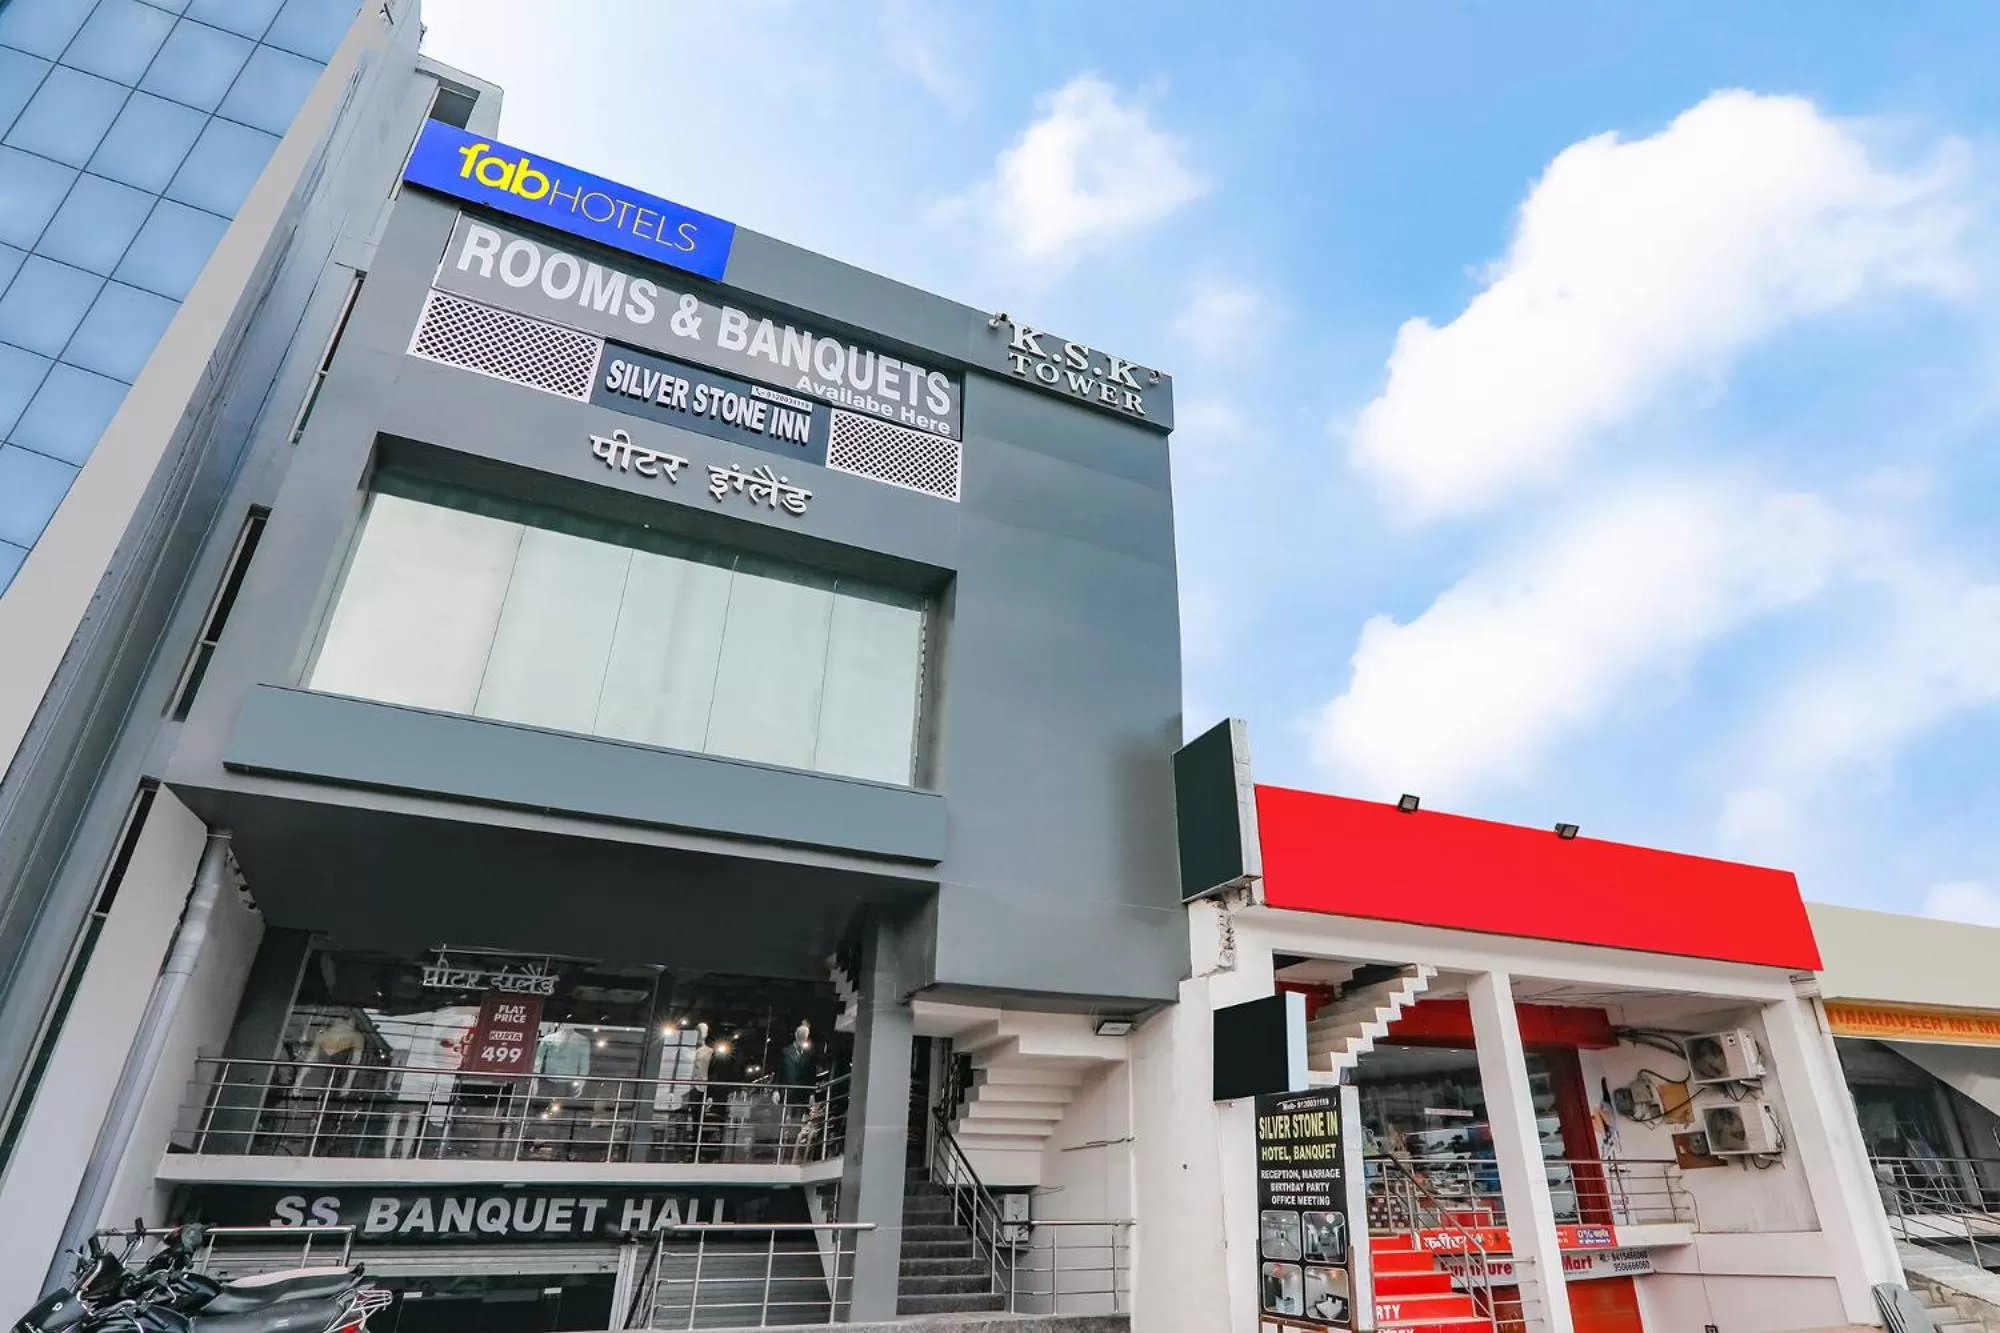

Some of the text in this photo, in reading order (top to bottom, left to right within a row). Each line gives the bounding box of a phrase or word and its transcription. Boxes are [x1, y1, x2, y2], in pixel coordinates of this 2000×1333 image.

[456, 224, 951, 415] ROOMS & BANQUETS
[1008, 352, 1146, 416] TOWER
[606, 359, 811, 444] SILVER STONE INN
[795, 375, 950, 435] Availabe Here
[589, 429, 814, 516] पीटर इंग्लैंड
[494, 1013, 528, 1024] PRICE
[499, 1004, 526, 1014] FLAT
[490, 1031, 523, 1041] KURTA
[1259, 1111, 1338, 1140] SILVER STONE IN
[1261, 1143, 1337, 1164] HOTEL, BANQUET
[1261, 1168, 1341, 1181] RECEPTION, MARRIAGE
[1270, 1182, 1330, 1193] BIRTHDAY PARTY
[1271, 1195, 1331, 1206] OFFICE MEETING
[270, 1196, 735, 1236] SS BANQUET HALL
[1562, 1254, 1593, 1270] Mart
